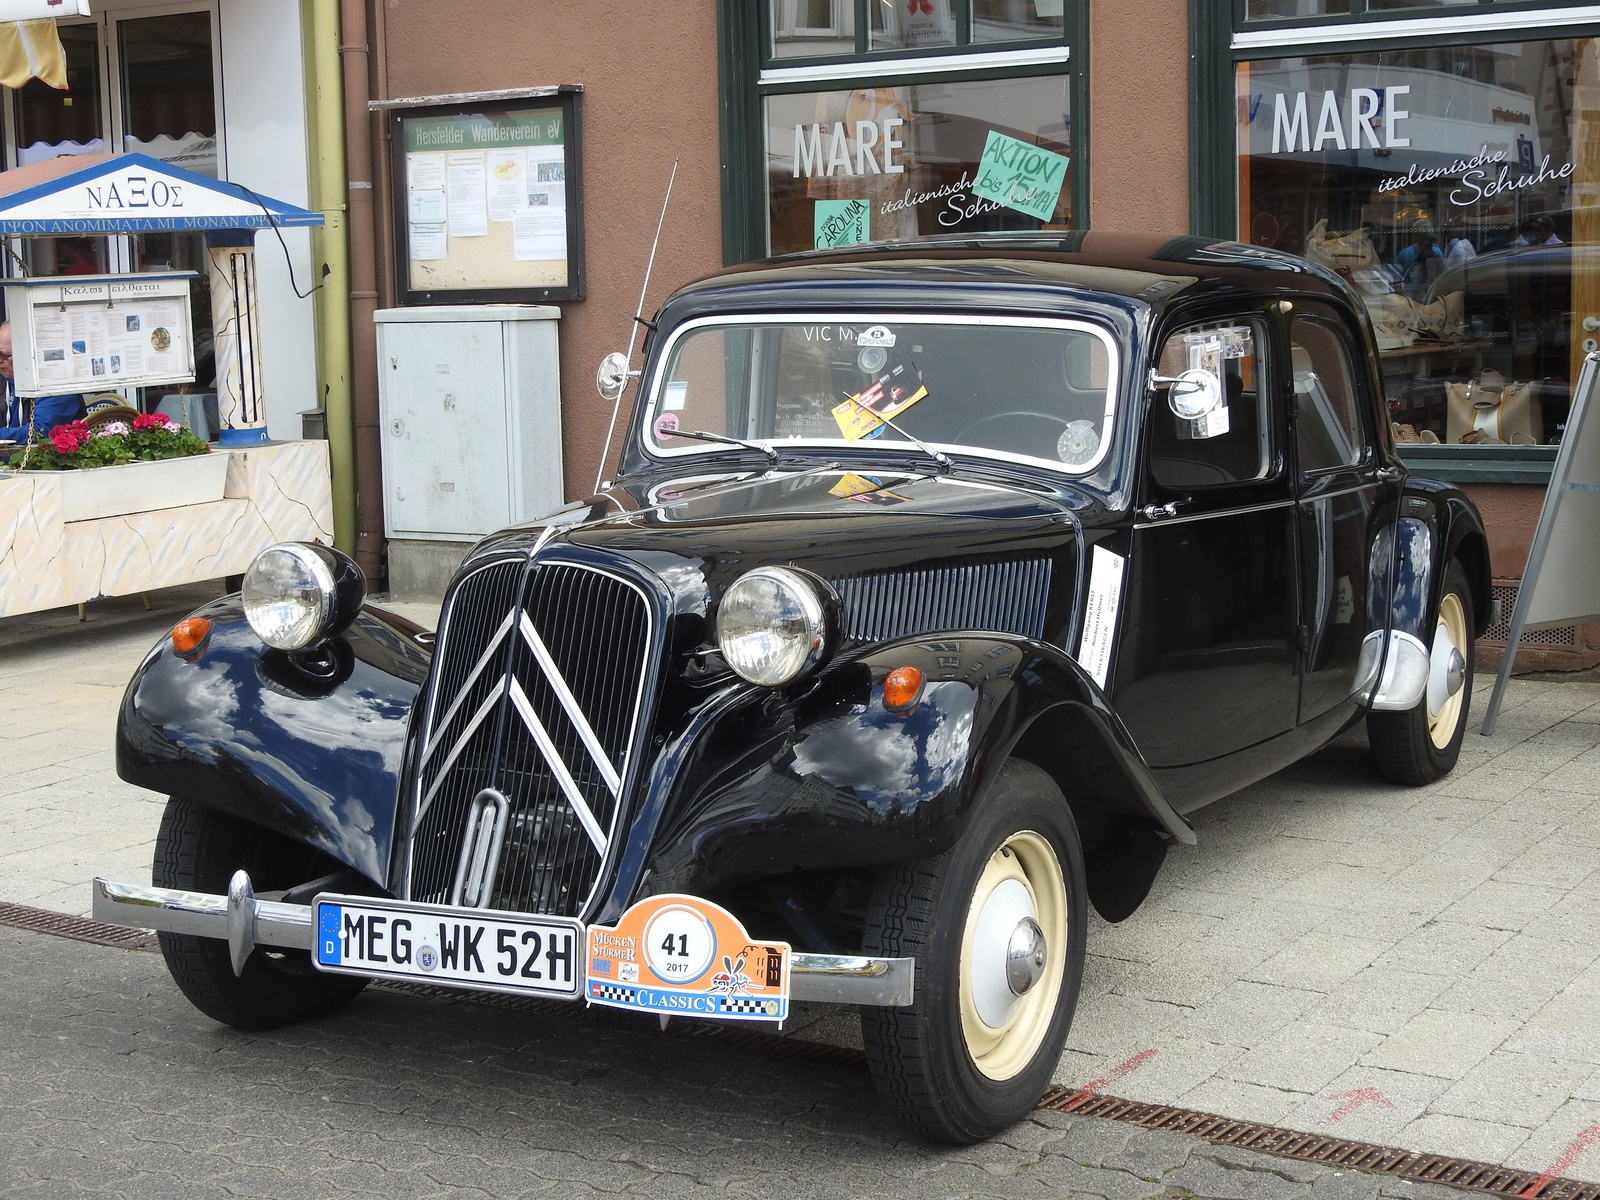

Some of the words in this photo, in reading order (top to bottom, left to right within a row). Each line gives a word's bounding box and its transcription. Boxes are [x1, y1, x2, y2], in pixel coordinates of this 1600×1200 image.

[416, 125, 465, 145] Hersfelder
[471, 120, 541, 143] Wanderverein
[548, 120, 560, 138] eV
[1272, 85, 1410, 153] MARE
[793, 118, 904, 178] MARE
[984, 137, 1061, 183] AKTION
[1378, 145, 1508, 193] italienische
[881, 171, 980, 214] italienische
[980, 169, 1002, 193] bis
[1450, 154, 1576, 206] Schuhe
[938, 181, 1037, 226] Schuhe
[803, 326, 831, 341] VIC
[1096, 627, 1108, 676] VOLKSWAGEN
[326, 940, 334, 954] D
[344, 913, 412, 965] MEG
[439, 923, 485, 973] WK
[497, 928, 571, 982] 52H
[661, 933, 689, 957] 41
[666, 962, 689, 973] 2017
[636, 988, 717, 1013] CLASSICS
